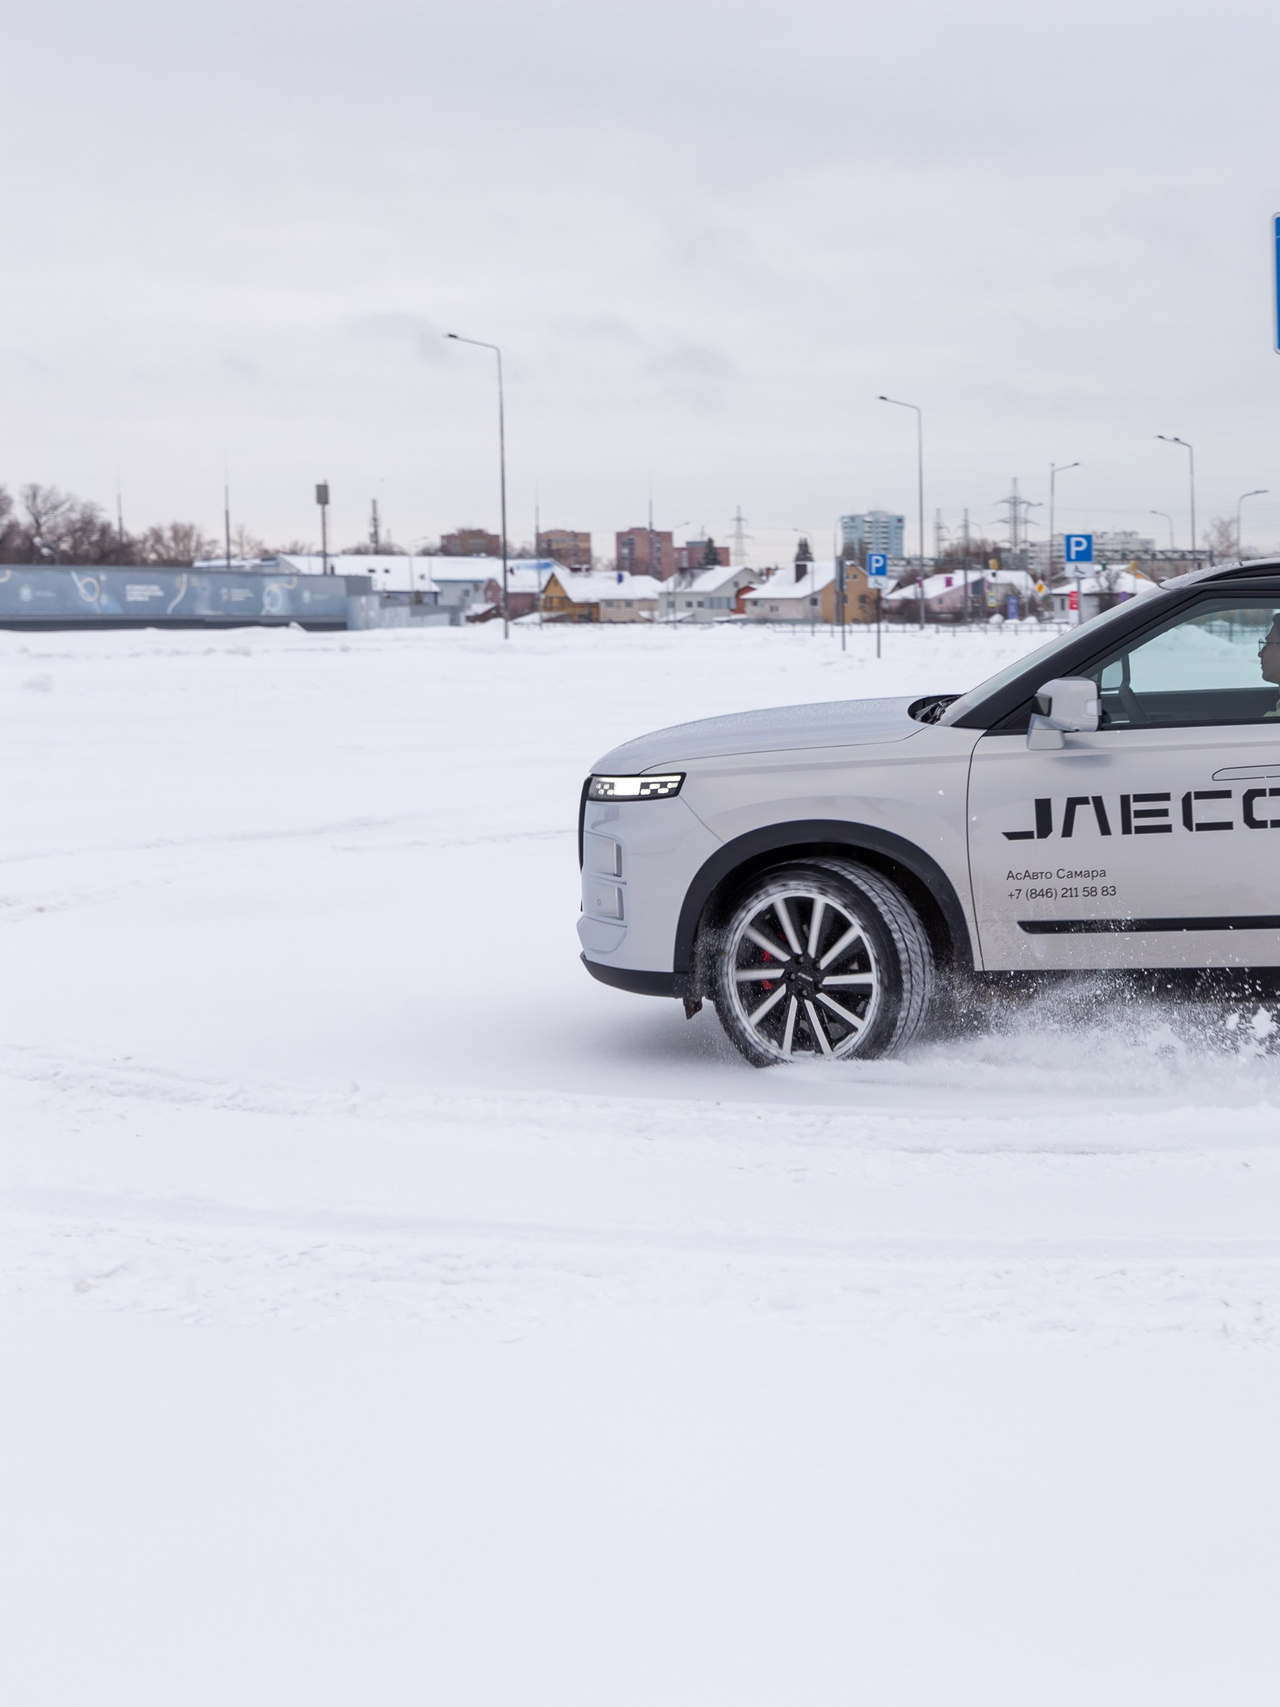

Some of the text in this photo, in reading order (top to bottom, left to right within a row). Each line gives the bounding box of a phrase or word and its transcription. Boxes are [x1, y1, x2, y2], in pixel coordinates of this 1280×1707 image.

[1071, 537, 1088, 559] P
[871, 556, 884, 573] P
[1006, 868, 1107, 880] АсАвто Самара
[1008, 885, 1117, 901] +7 (846) 211 58 83
